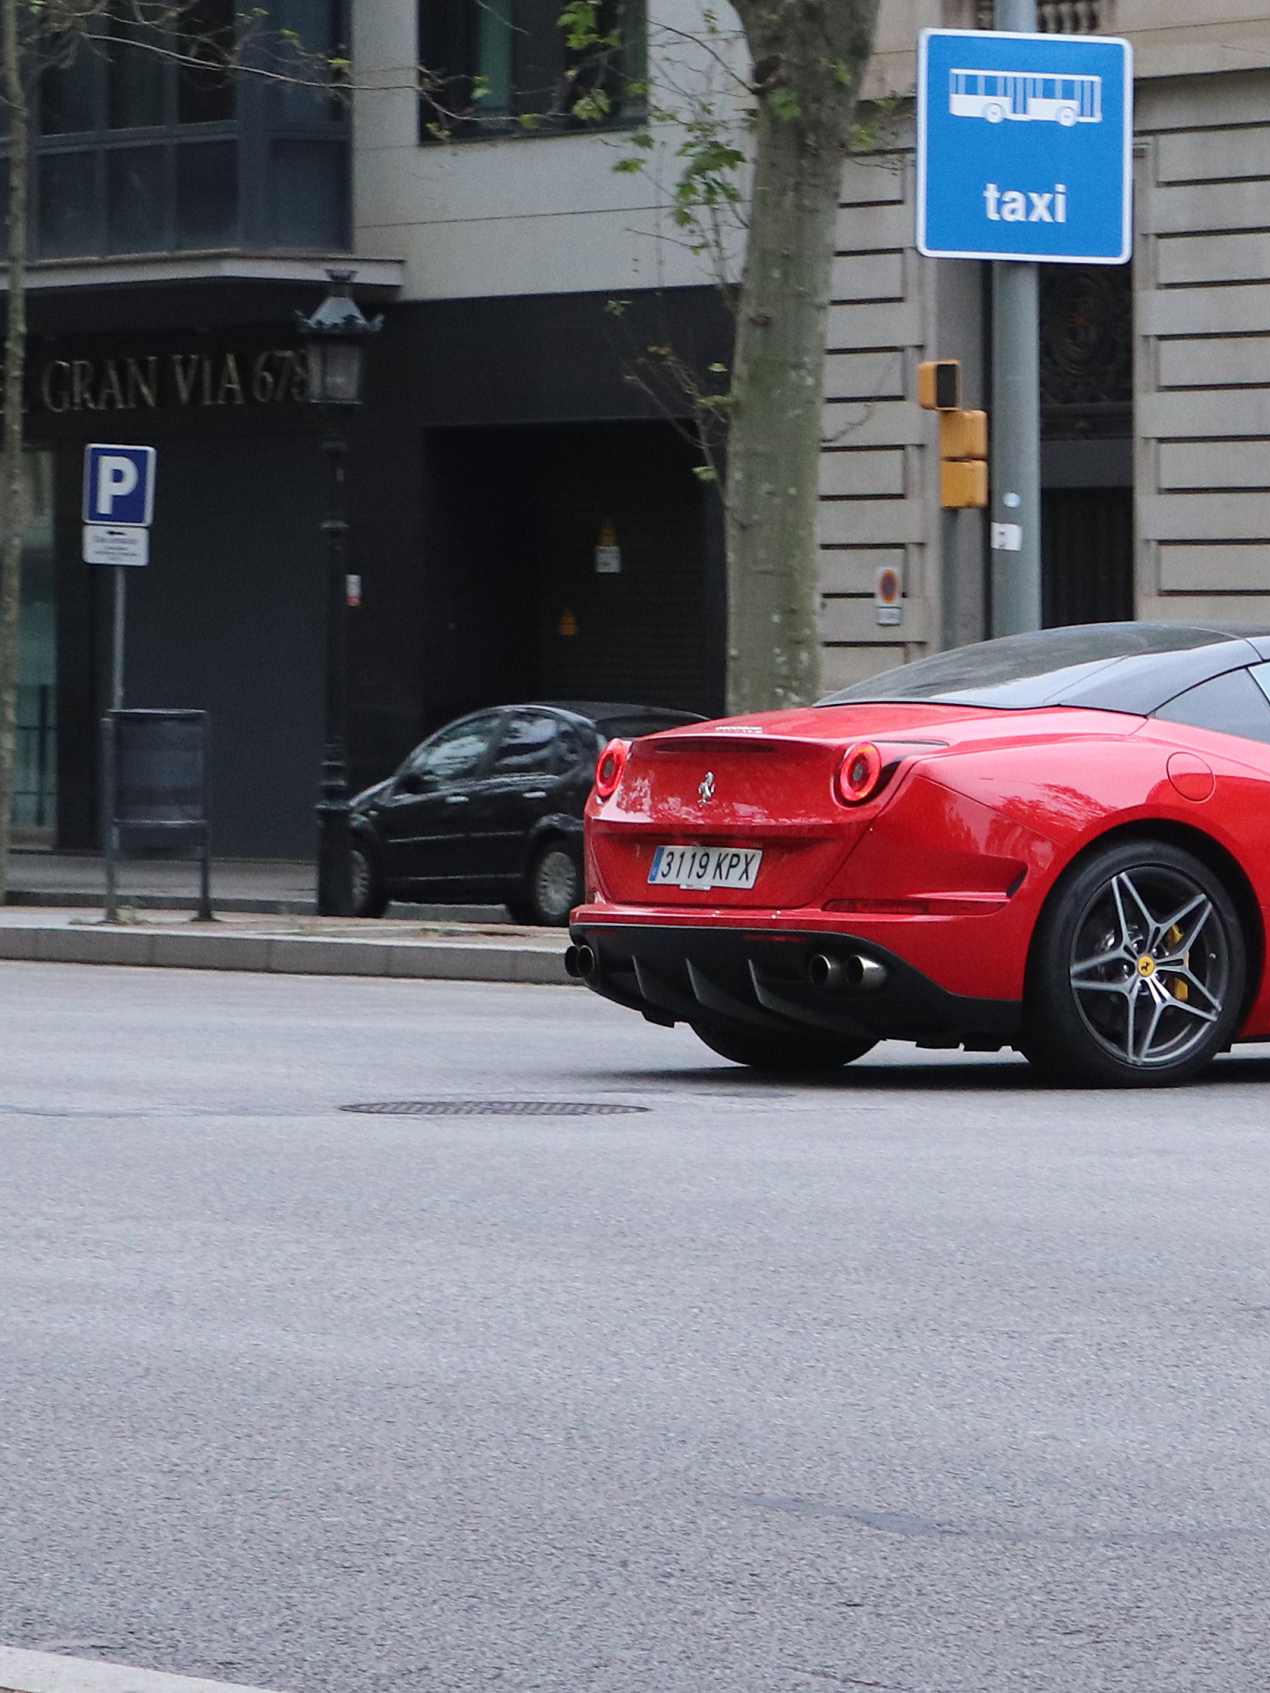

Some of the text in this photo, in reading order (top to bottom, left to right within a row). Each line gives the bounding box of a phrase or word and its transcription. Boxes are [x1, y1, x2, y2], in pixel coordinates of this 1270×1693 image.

[982, 183, 1067, 223] taxi
[41, 357, 157, 413] GRAN
[170, 353, 245, 405] VIA
[96, 455, 139, 515] P
[661, 851, 756, 881] 3119 KPX
